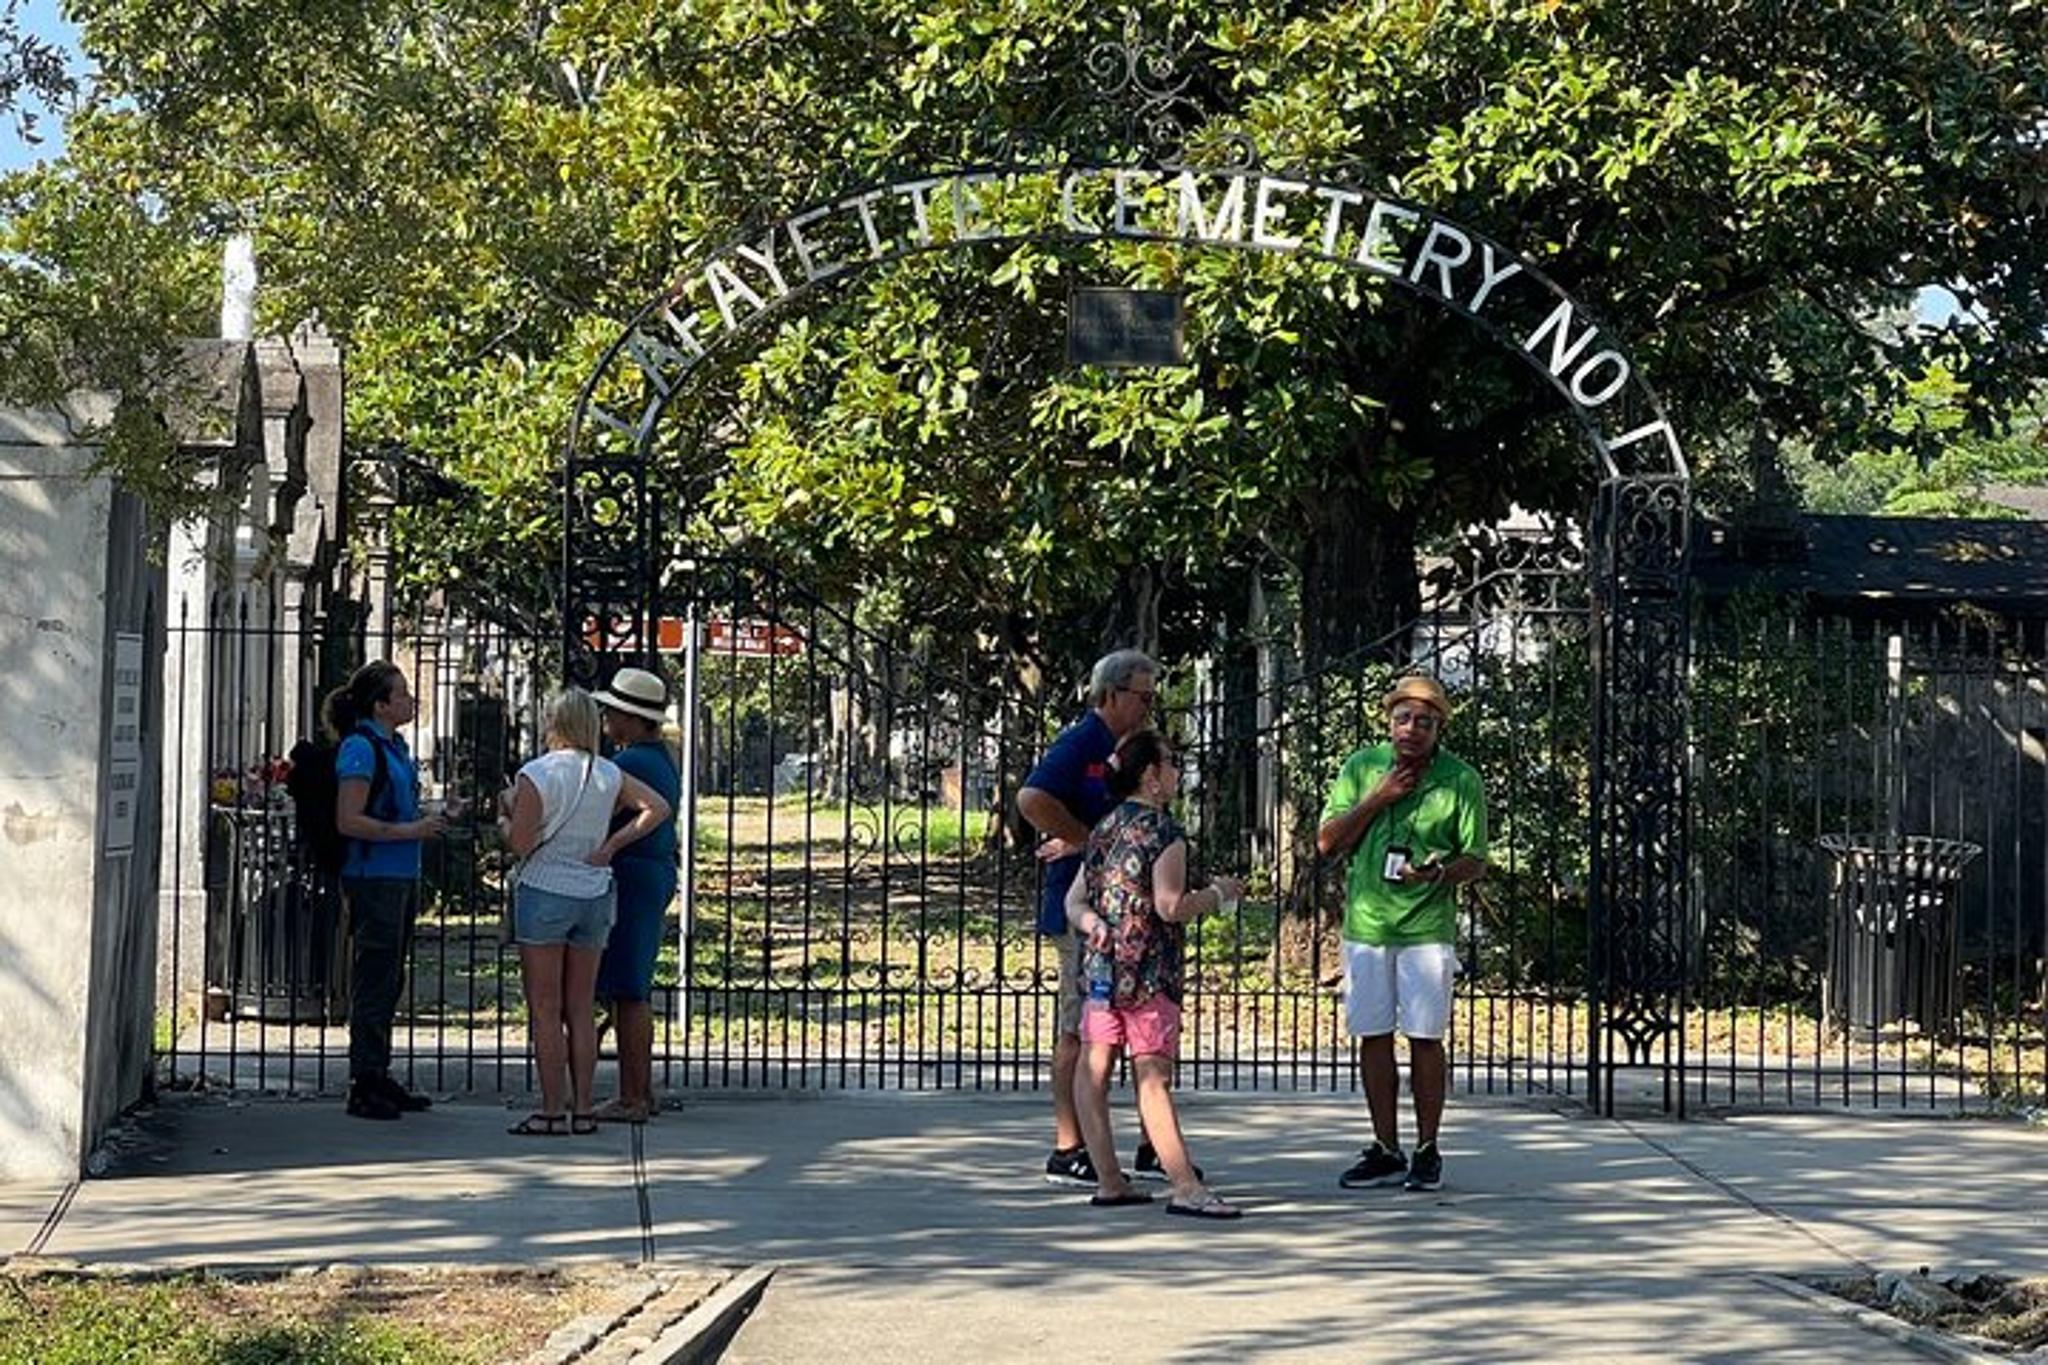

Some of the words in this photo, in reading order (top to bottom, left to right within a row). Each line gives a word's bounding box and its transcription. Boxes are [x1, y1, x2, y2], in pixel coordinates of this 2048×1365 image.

[587, 173, 1001, 440] LAFAYETTE
[1061, 168, 1522, 314] CEMETERY
[1524, 299, 1631, 408] NO
